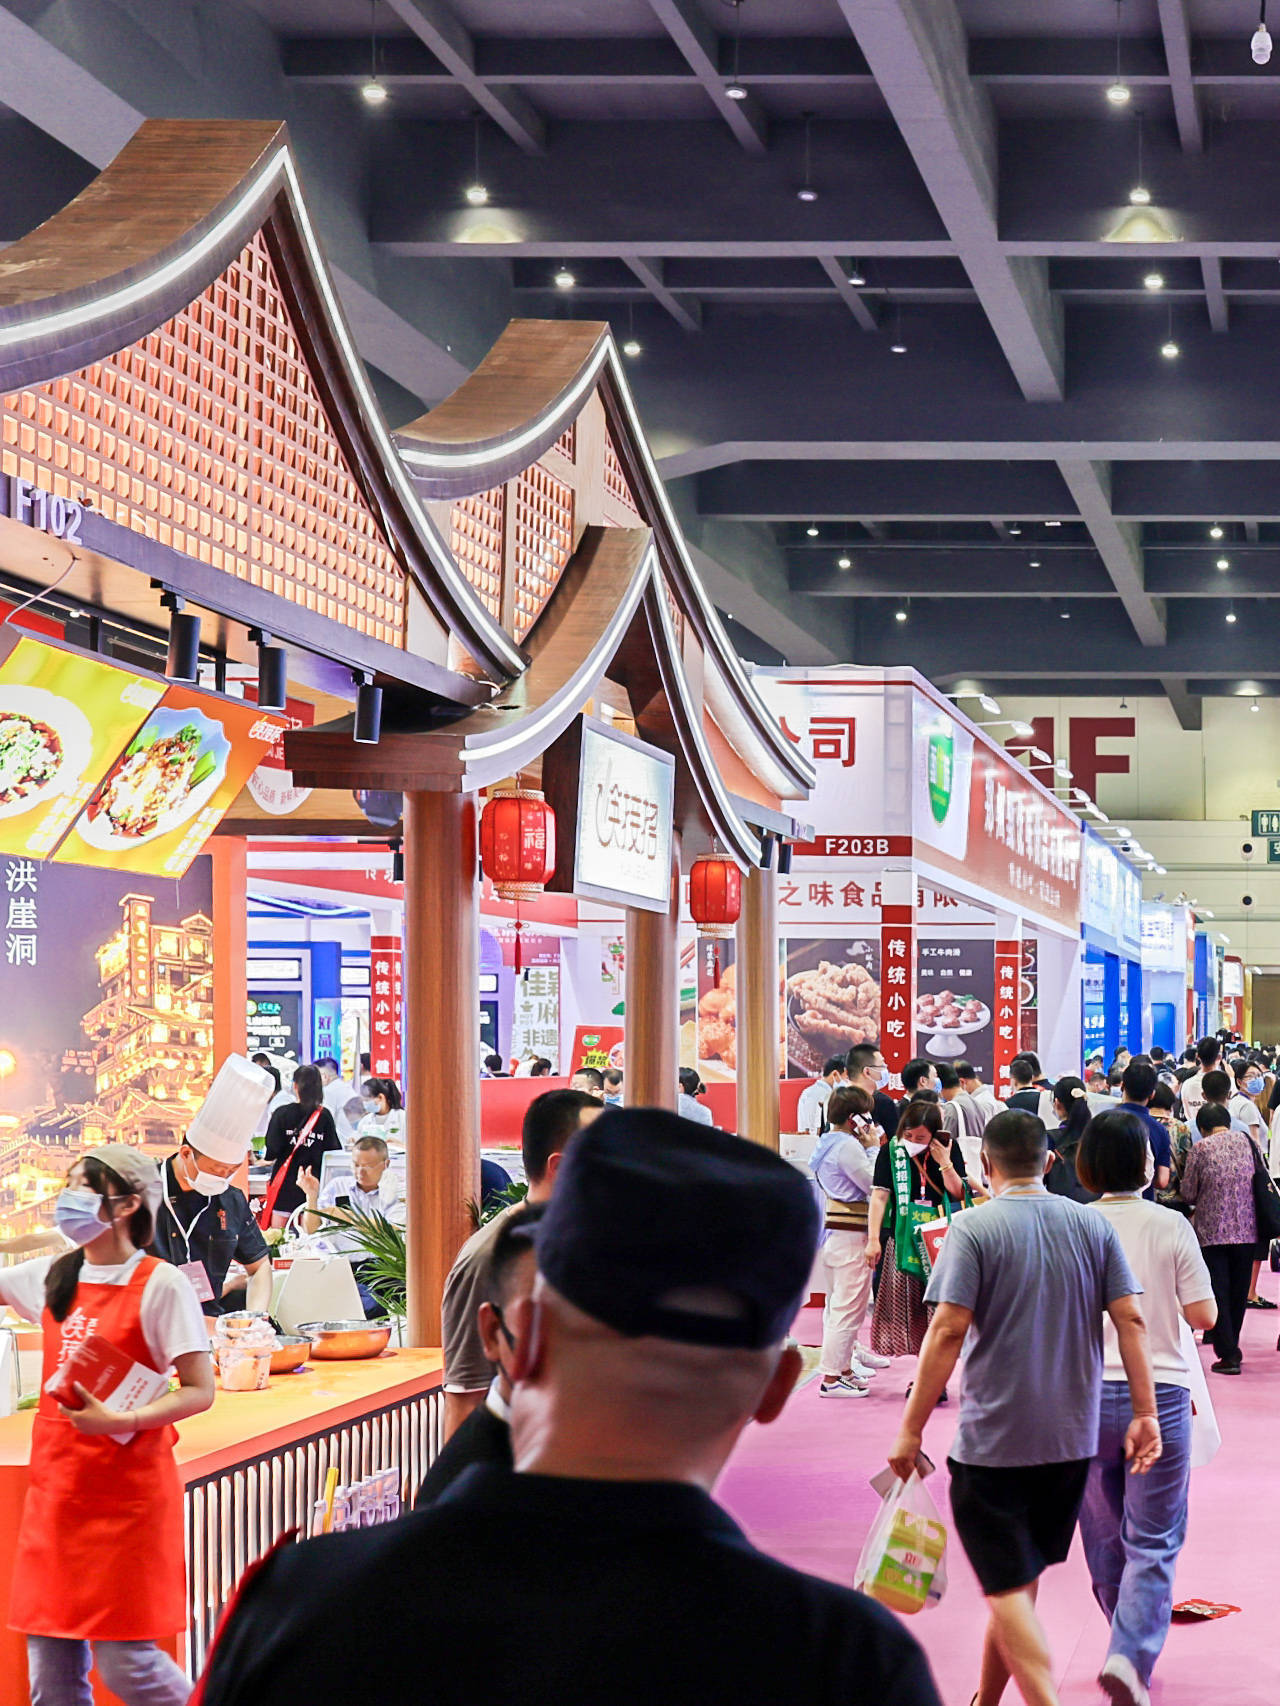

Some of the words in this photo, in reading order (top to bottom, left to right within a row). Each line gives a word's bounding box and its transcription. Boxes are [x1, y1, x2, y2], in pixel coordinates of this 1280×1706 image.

[17, 476, 83, 546] F102
[523, 827, 545, 850] 福
[825, 838, 889, 855] F203B
[5, 860, 38, 966] 洪崖洞
